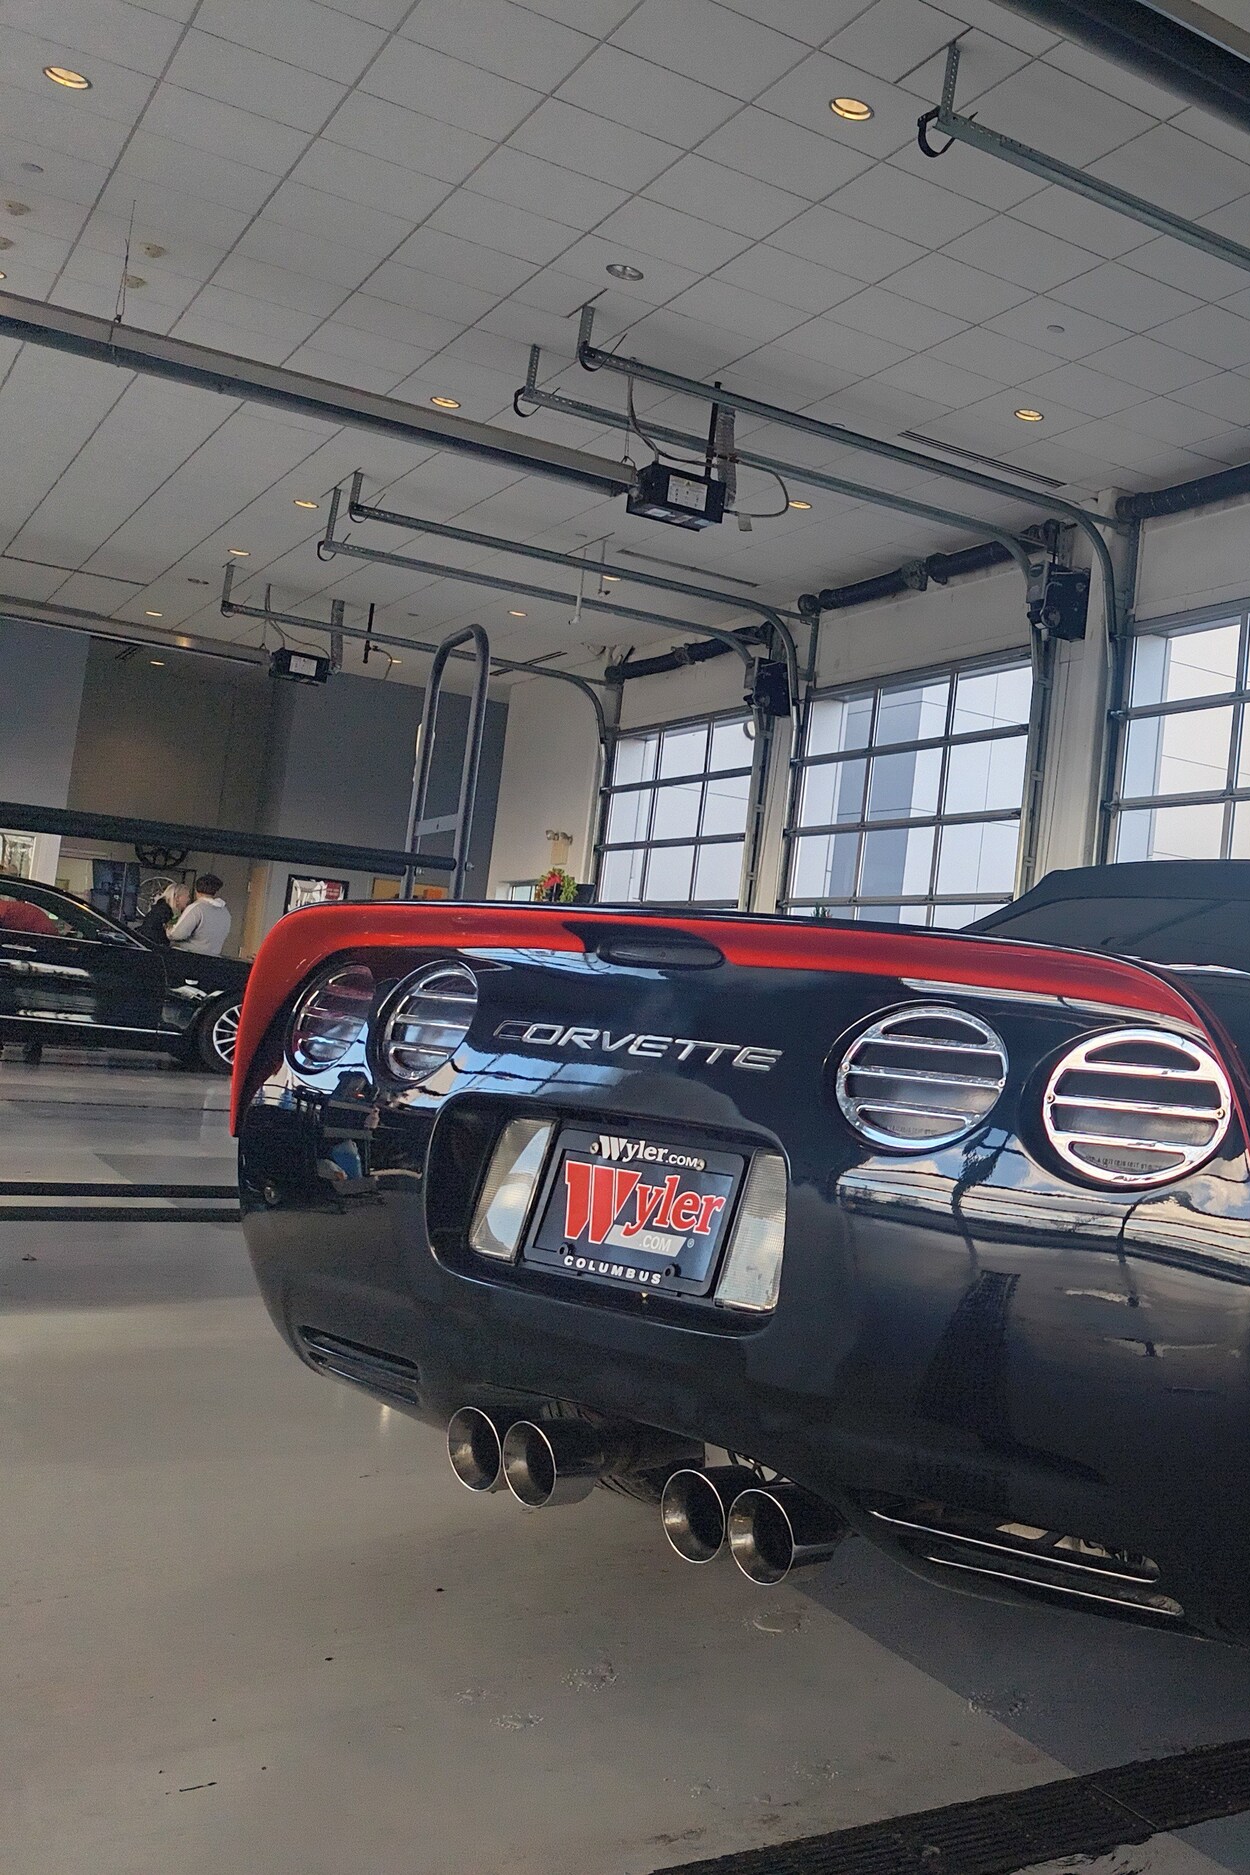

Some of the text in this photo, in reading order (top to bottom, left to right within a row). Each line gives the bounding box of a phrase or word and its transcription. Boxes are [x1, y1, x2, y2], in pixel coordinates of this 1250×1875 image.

[493, 1019, 783, 1071] CORVETTE
[565, 1160, 727, 1244] Wyler
[639, 1234, 672, 1252] .COM
[563, 1255, 662, 1284] COLUMBUS
